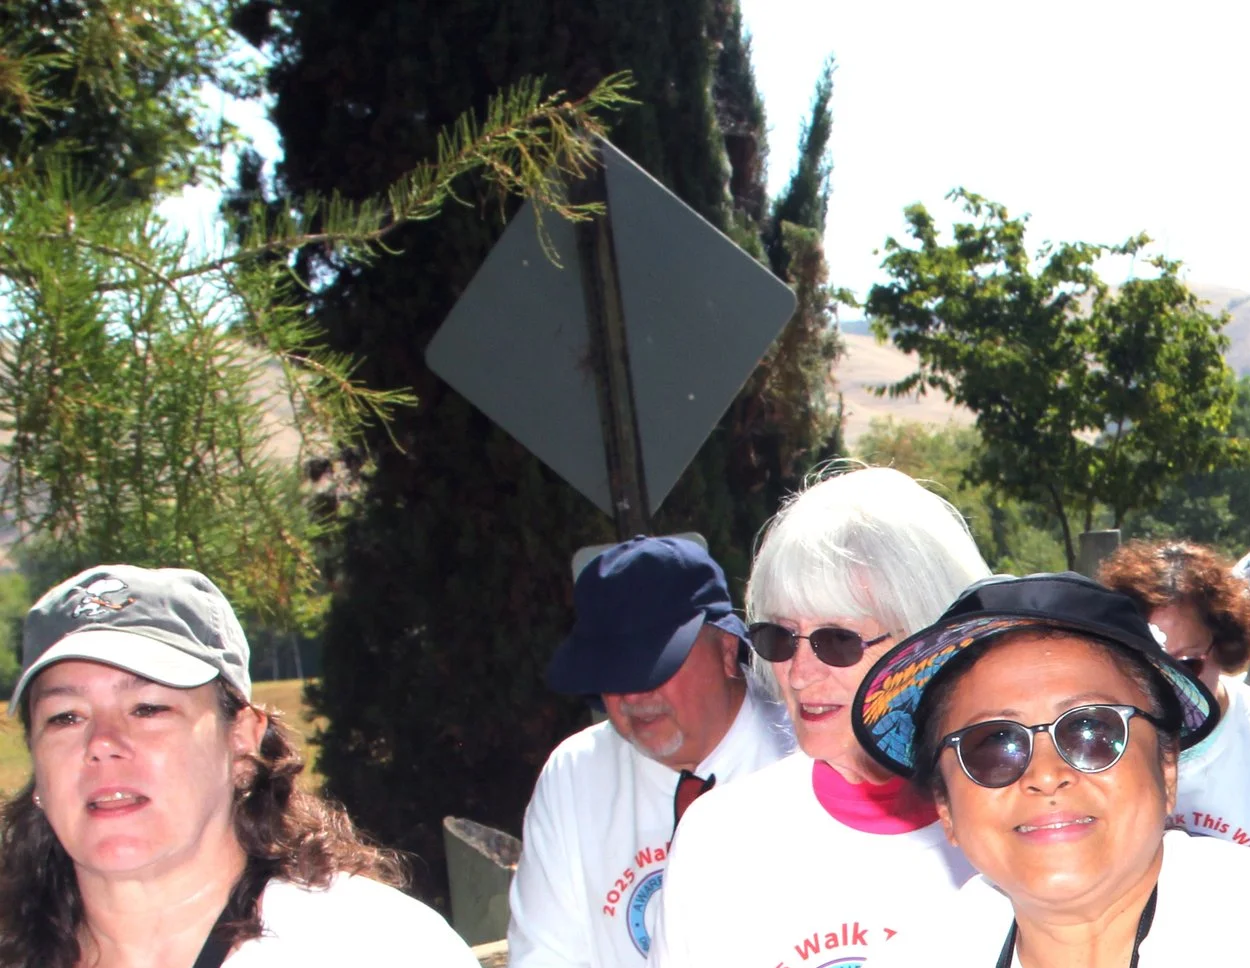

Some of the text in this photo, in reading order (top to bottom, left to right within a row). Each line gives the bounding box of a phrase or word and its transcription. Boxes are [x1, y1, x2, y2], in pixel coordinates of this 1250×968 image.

[1192, 811, 1230, 834] This
[603, 841, 671, 917] 2025 Wal
[794, 921, 868, 961] Walk
